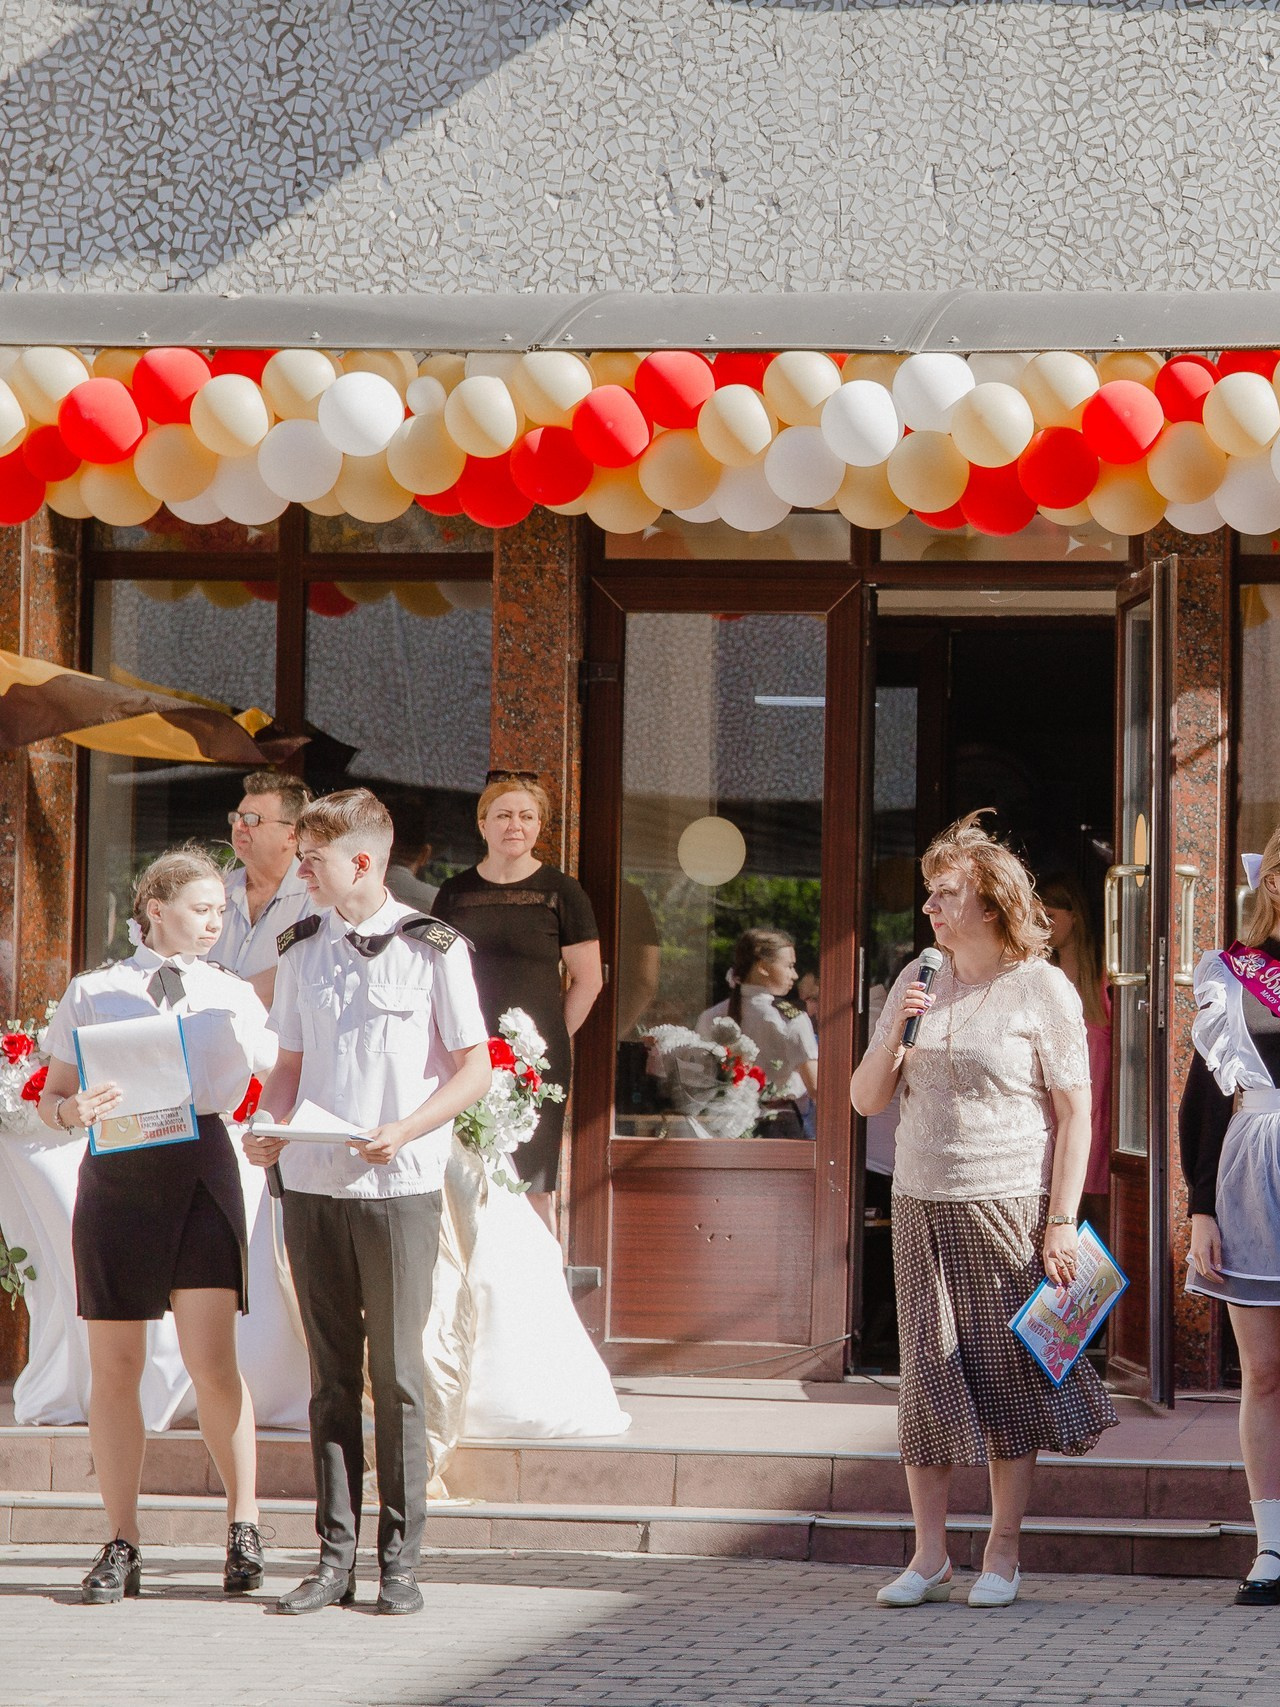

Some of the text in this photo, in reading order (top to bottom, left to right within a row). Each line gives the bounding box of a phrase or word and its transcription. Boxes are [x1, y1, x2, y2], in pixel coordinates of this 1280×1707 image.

[437, 932, 454, 950] 33
[1260, 990, 1279, 1005] МАОУ
[143, 1124, 187, 1139] ЗВОНОК!
